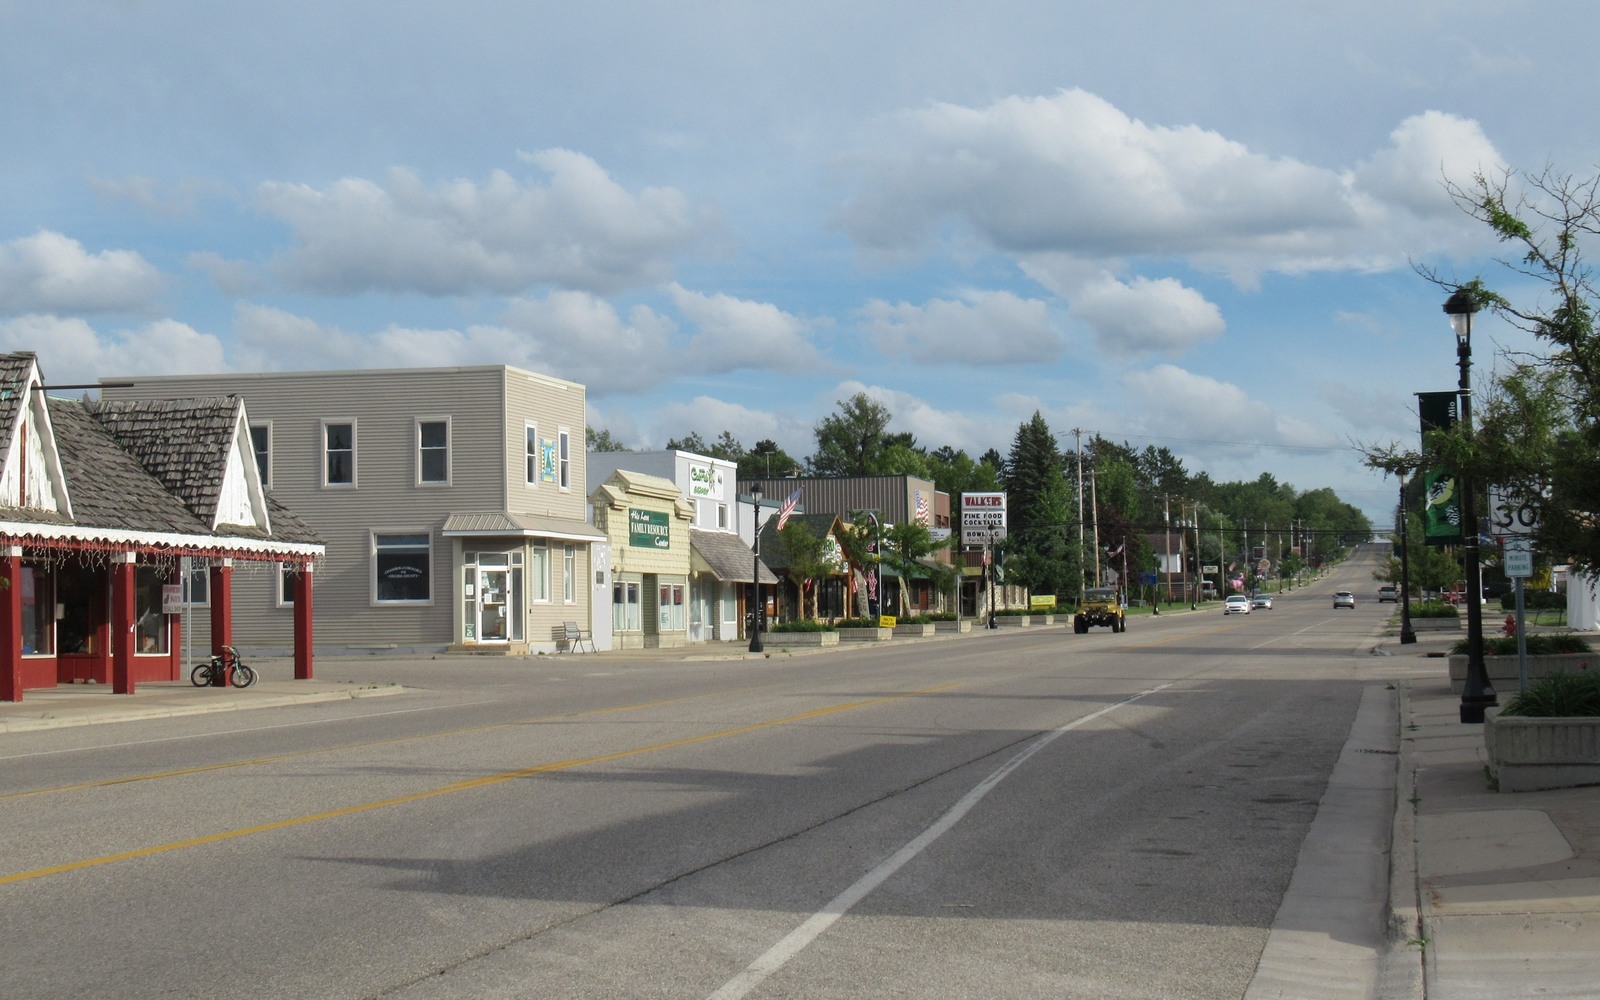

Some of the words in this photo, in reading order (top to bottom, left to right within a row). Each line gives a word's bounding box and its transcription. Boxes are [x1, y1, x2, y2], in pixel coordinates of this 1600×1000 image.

[1448, 401, 1456, 417] Mio
[631, 510, 640, 520] His
[1496, 504, 1537, 527] 30
[631, 522, 647, 535] FAMILY
[647, 524, 669, 537] RESOURCE
[1507, 563, 1530, 571] PARKING
